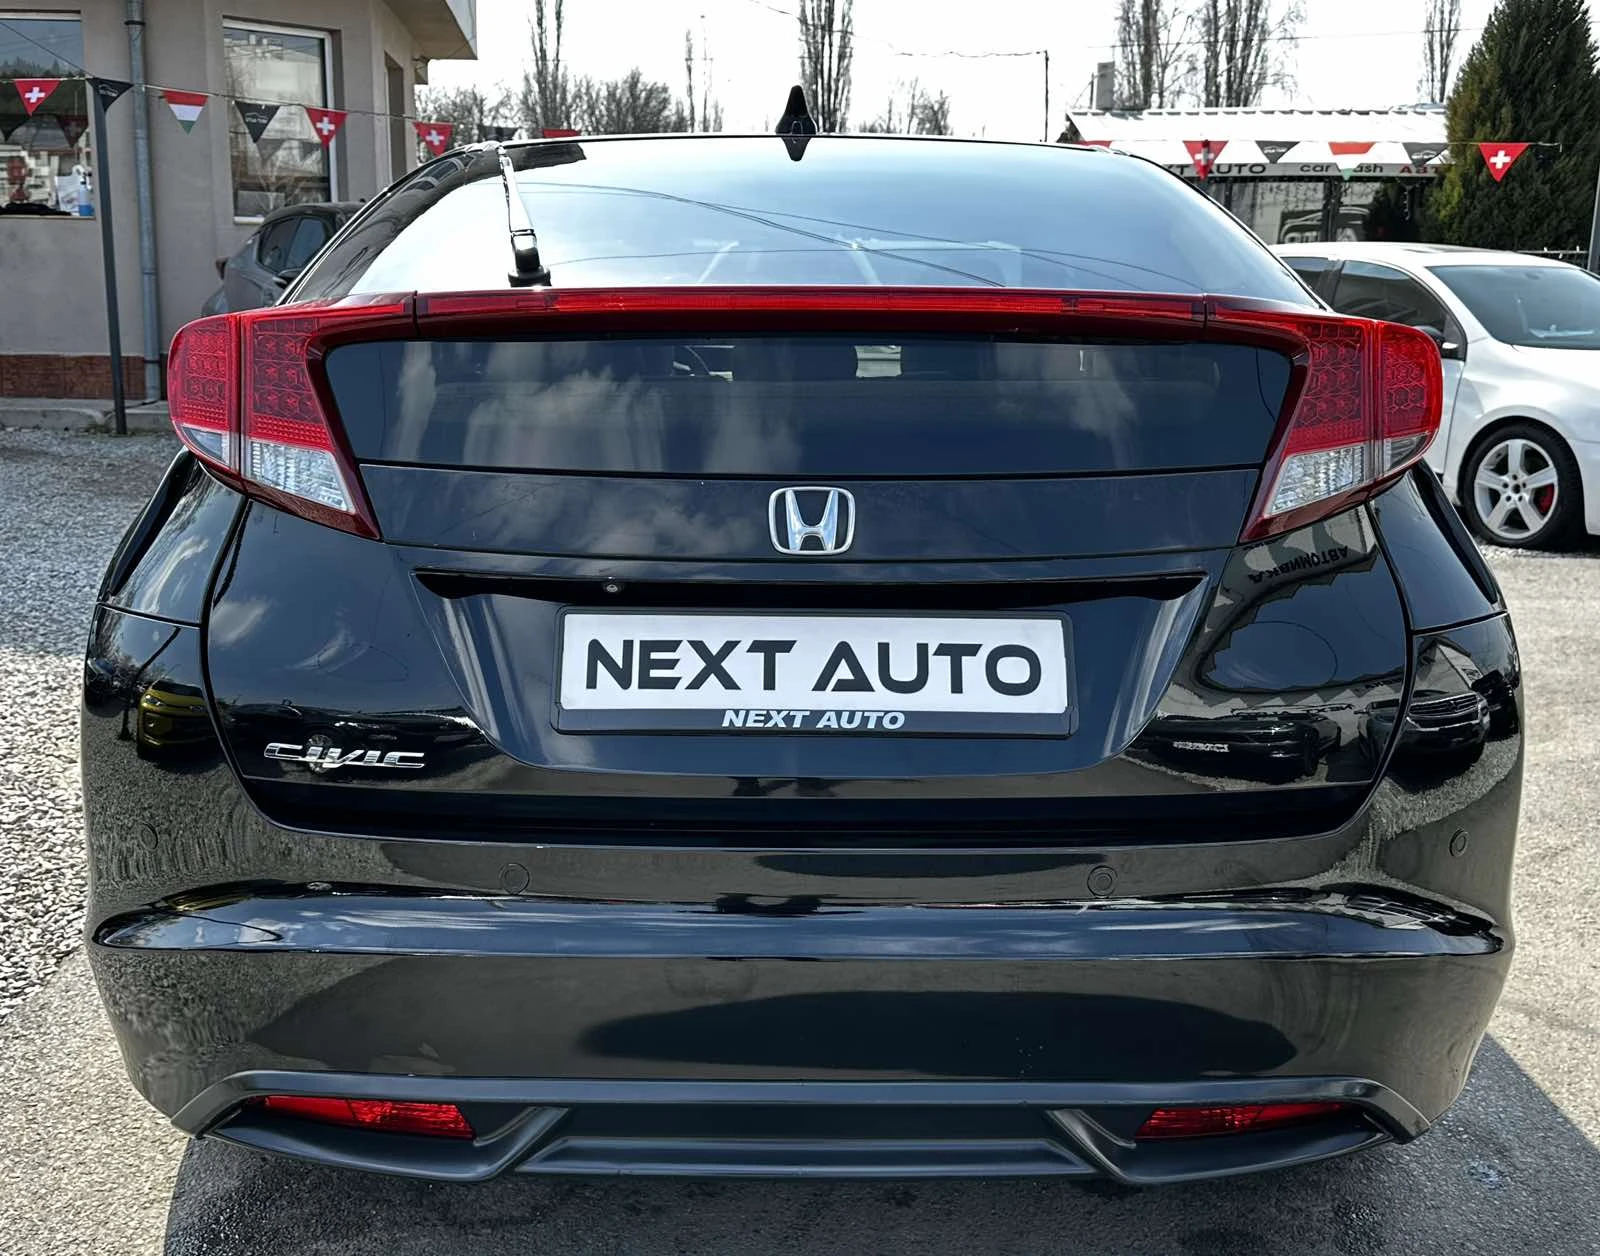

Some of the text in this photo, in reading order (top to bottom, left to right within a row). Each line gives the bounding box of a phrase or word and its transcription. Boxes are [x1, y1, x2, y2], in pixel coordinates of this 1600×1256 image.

[1299, 163, 1384, 173] car ash
[585, 638, 1042, 696] NEXT AUTO
[722, 710, 906, 730] NEXT AUTO
[264, 743, 425, 769] CIVIC
